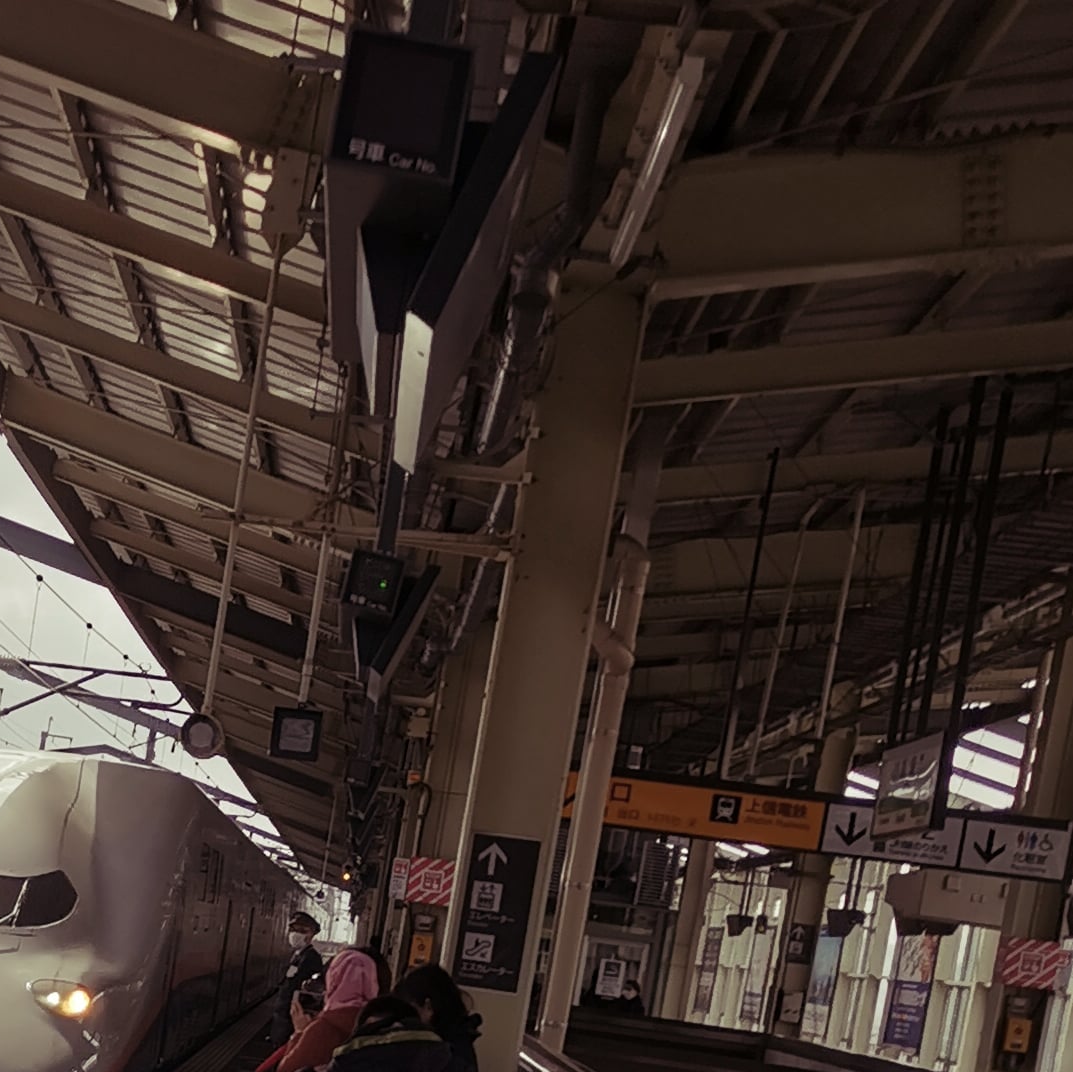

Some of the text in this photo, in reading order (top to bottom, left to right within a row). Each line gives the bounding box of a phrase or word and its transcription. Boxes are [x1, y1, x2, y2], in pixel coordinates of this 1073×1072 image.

[469, 910, 516, 924] エレベーター
[461, 961, 515, 976] エスカレーター
